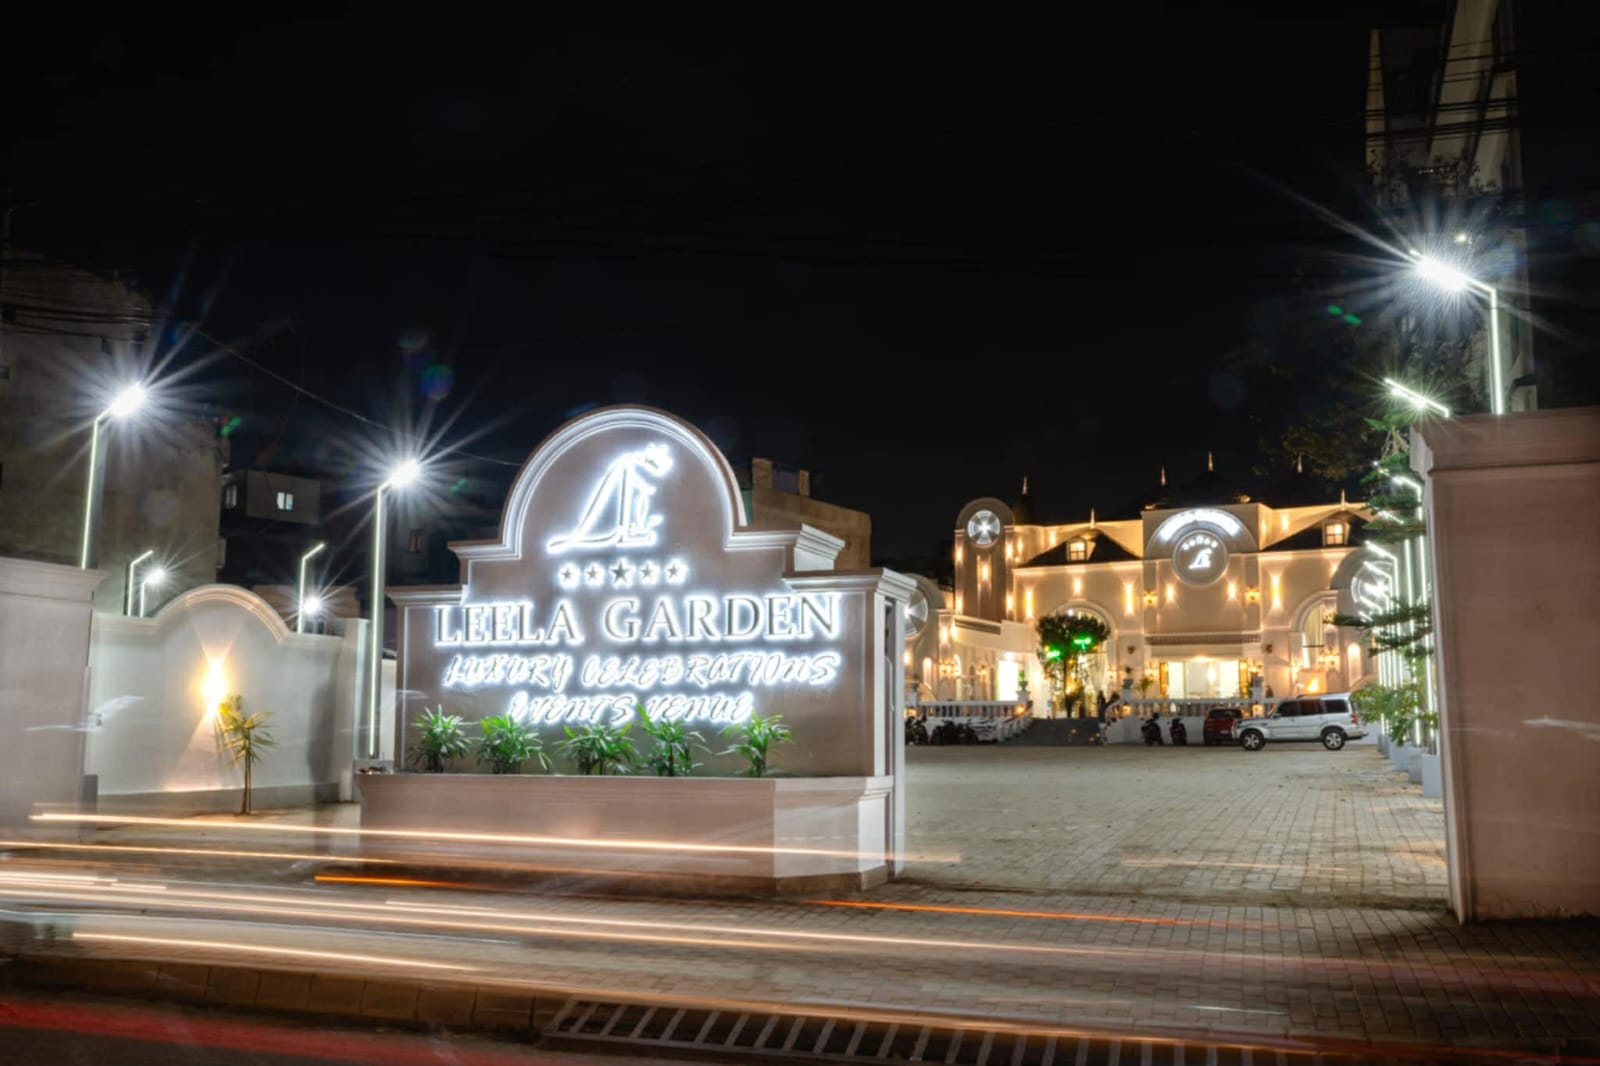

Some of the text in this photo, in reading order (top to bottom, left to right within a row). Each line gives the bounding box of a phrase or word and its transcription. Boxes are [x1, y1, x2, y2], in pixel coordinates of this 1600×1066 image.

[435, 594, 839, 645] LEELA GARDEN
[444, 652, 838, 690] LUXURY CELEBRATIONS
[508, 693, 753, 725] EVENTS VENUE
